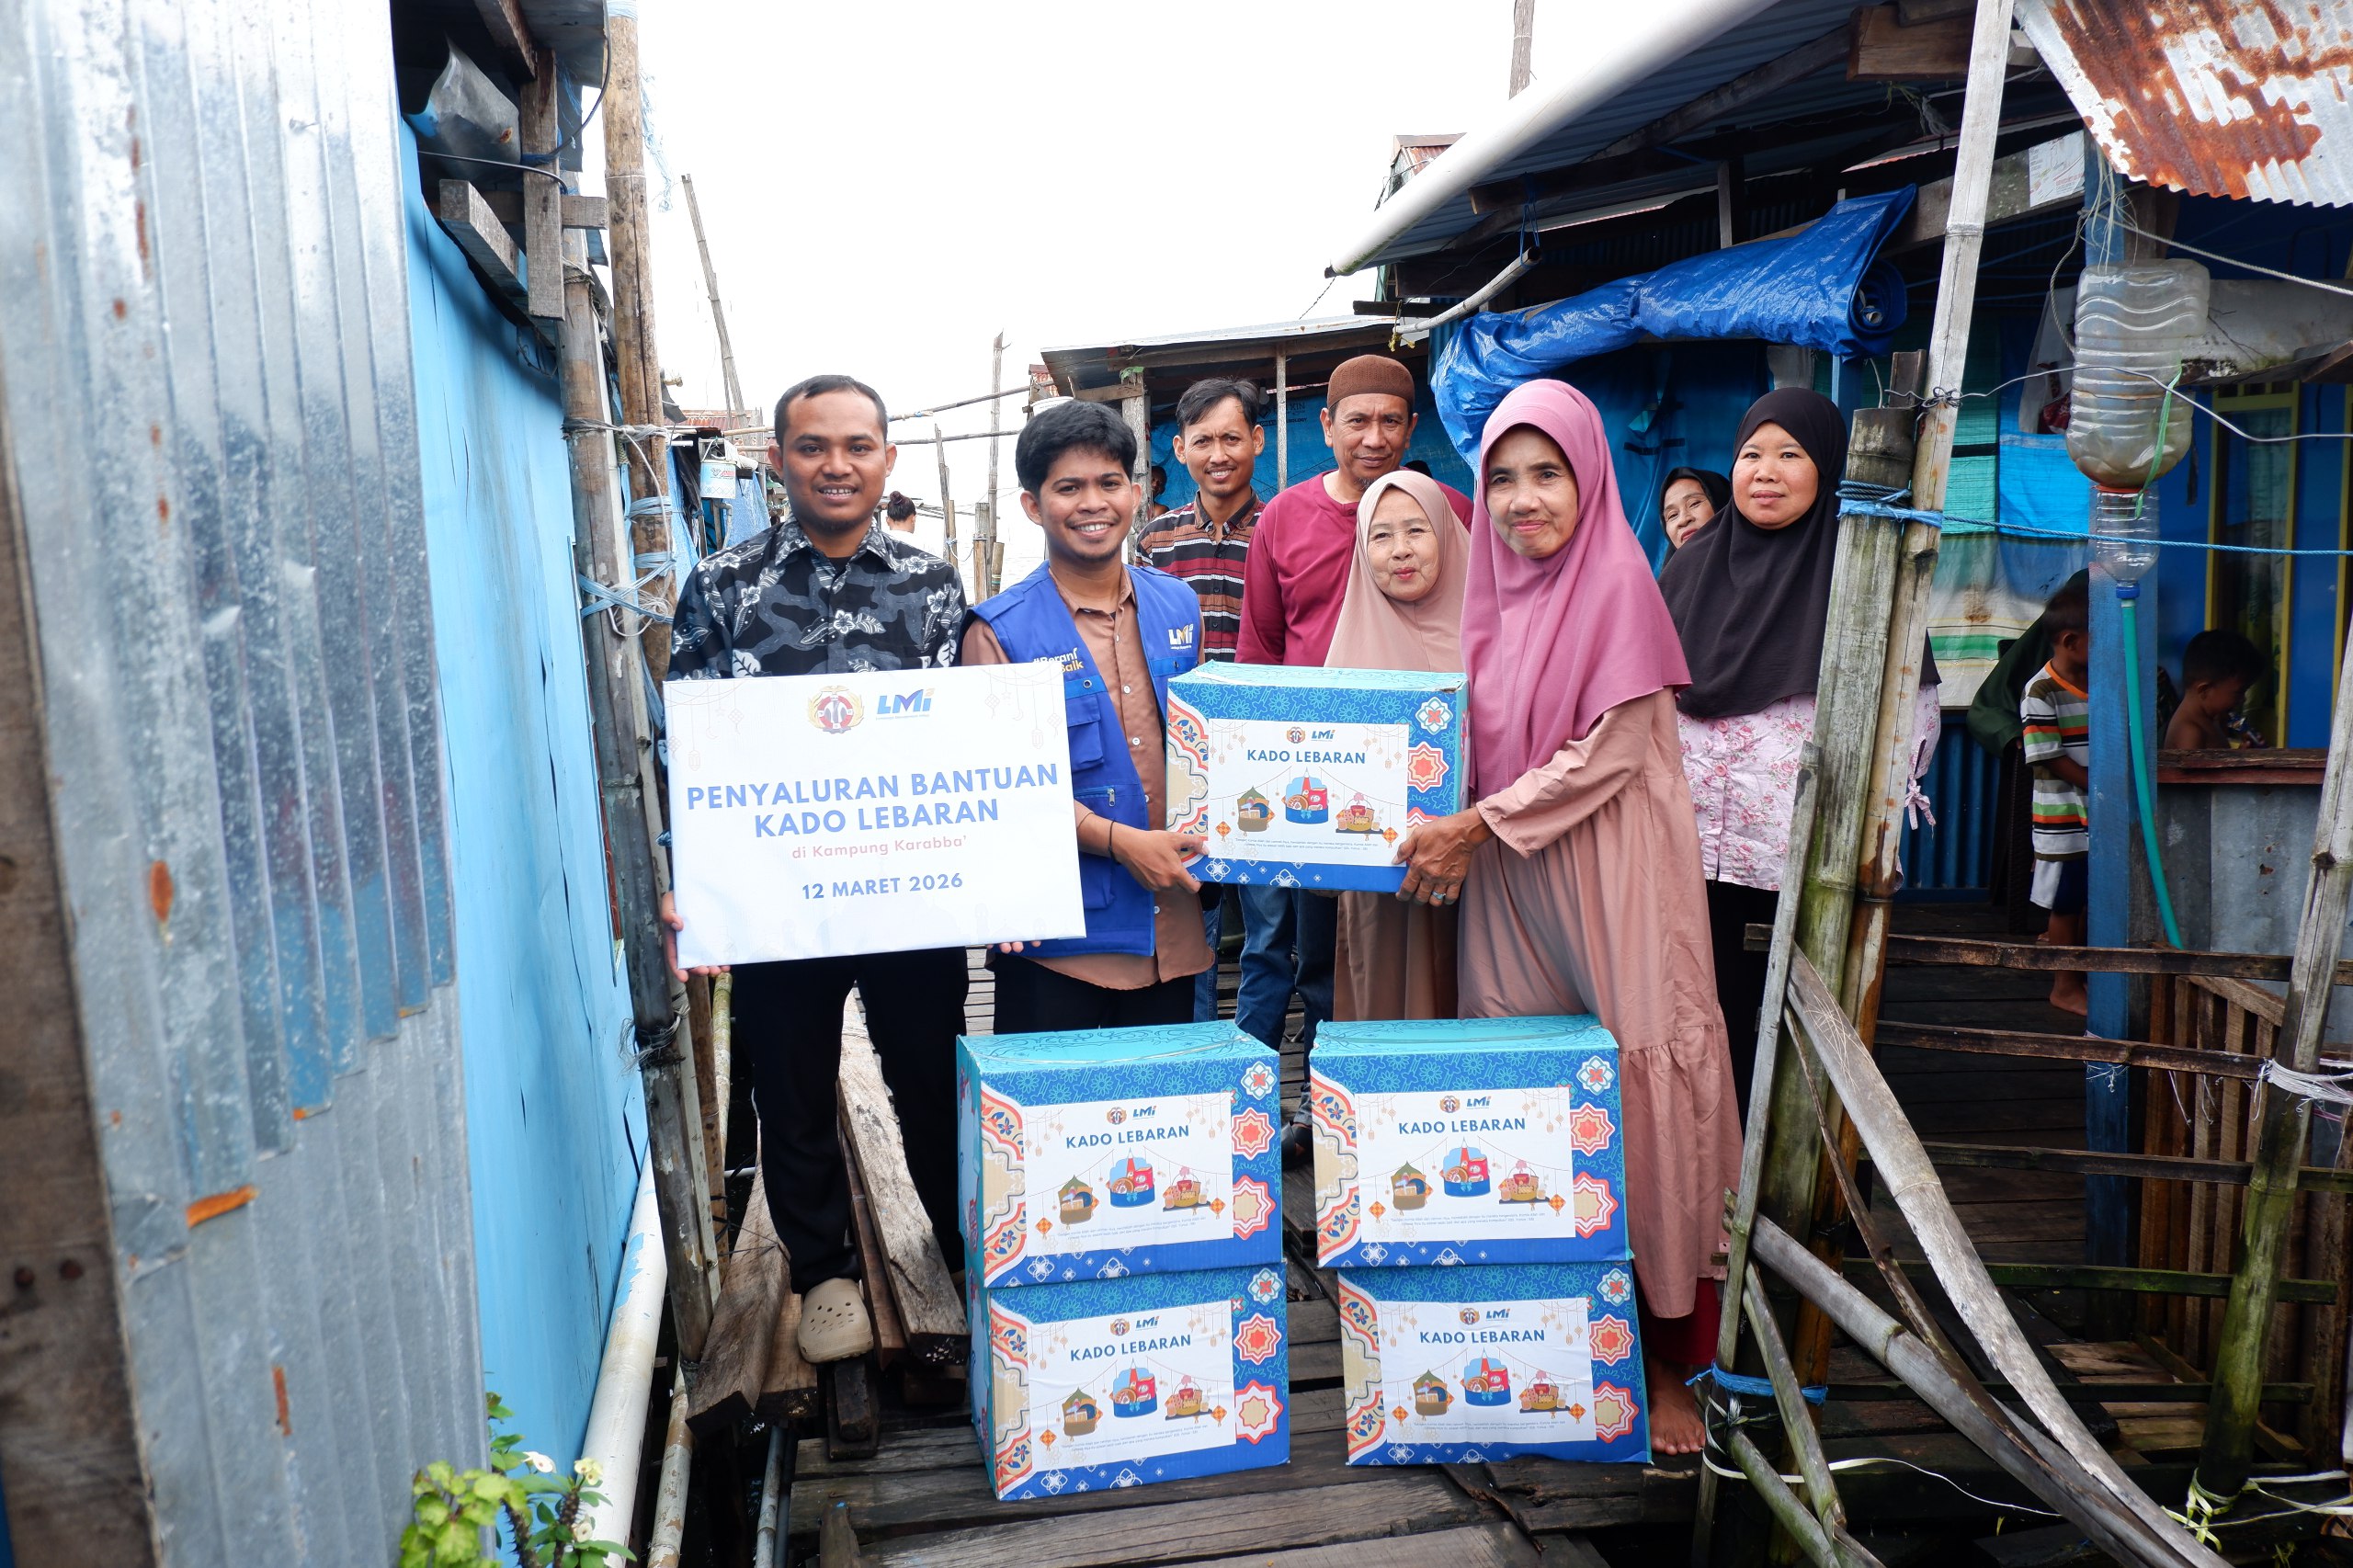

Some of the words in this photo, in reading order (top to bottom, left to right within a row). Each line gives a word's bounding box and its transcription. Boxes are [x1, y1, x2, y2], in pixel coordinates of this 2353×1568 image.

[1247, 749, 1290, 763] KADO
[1296, 751, 1366, 764] LEBARAN
[688, 775, 899, 810] PENYALURAN
[911, 764, 1058, 795] BANTUAN
[755, 810, 846, 837] KADO
[858, 799, 998, 830] LEBARAN
[792, 846, 806, 858] di
[813, 843, 889, 858] Kampung
[802, 883, 824, 899] 12
[832, 877, 901, 897] MARET
[909, 872, 963, 892] 2026
[1066, 1133, 1112, 1149] KADO
[1118, 1125, 1189, 1143] LEBARAN
[1398, 1120, 1445, 1134] KADO
[1451, 1118, 1526, 1132] LEBARAN
[1070, 1346, 1115, 1361] KADO
[1121, 1335, 1192, 1356] LEBARAN
[1419, 1331, 1466, 1344] KADO
[1472, 1329, 1545, 1343] LEBARAN
